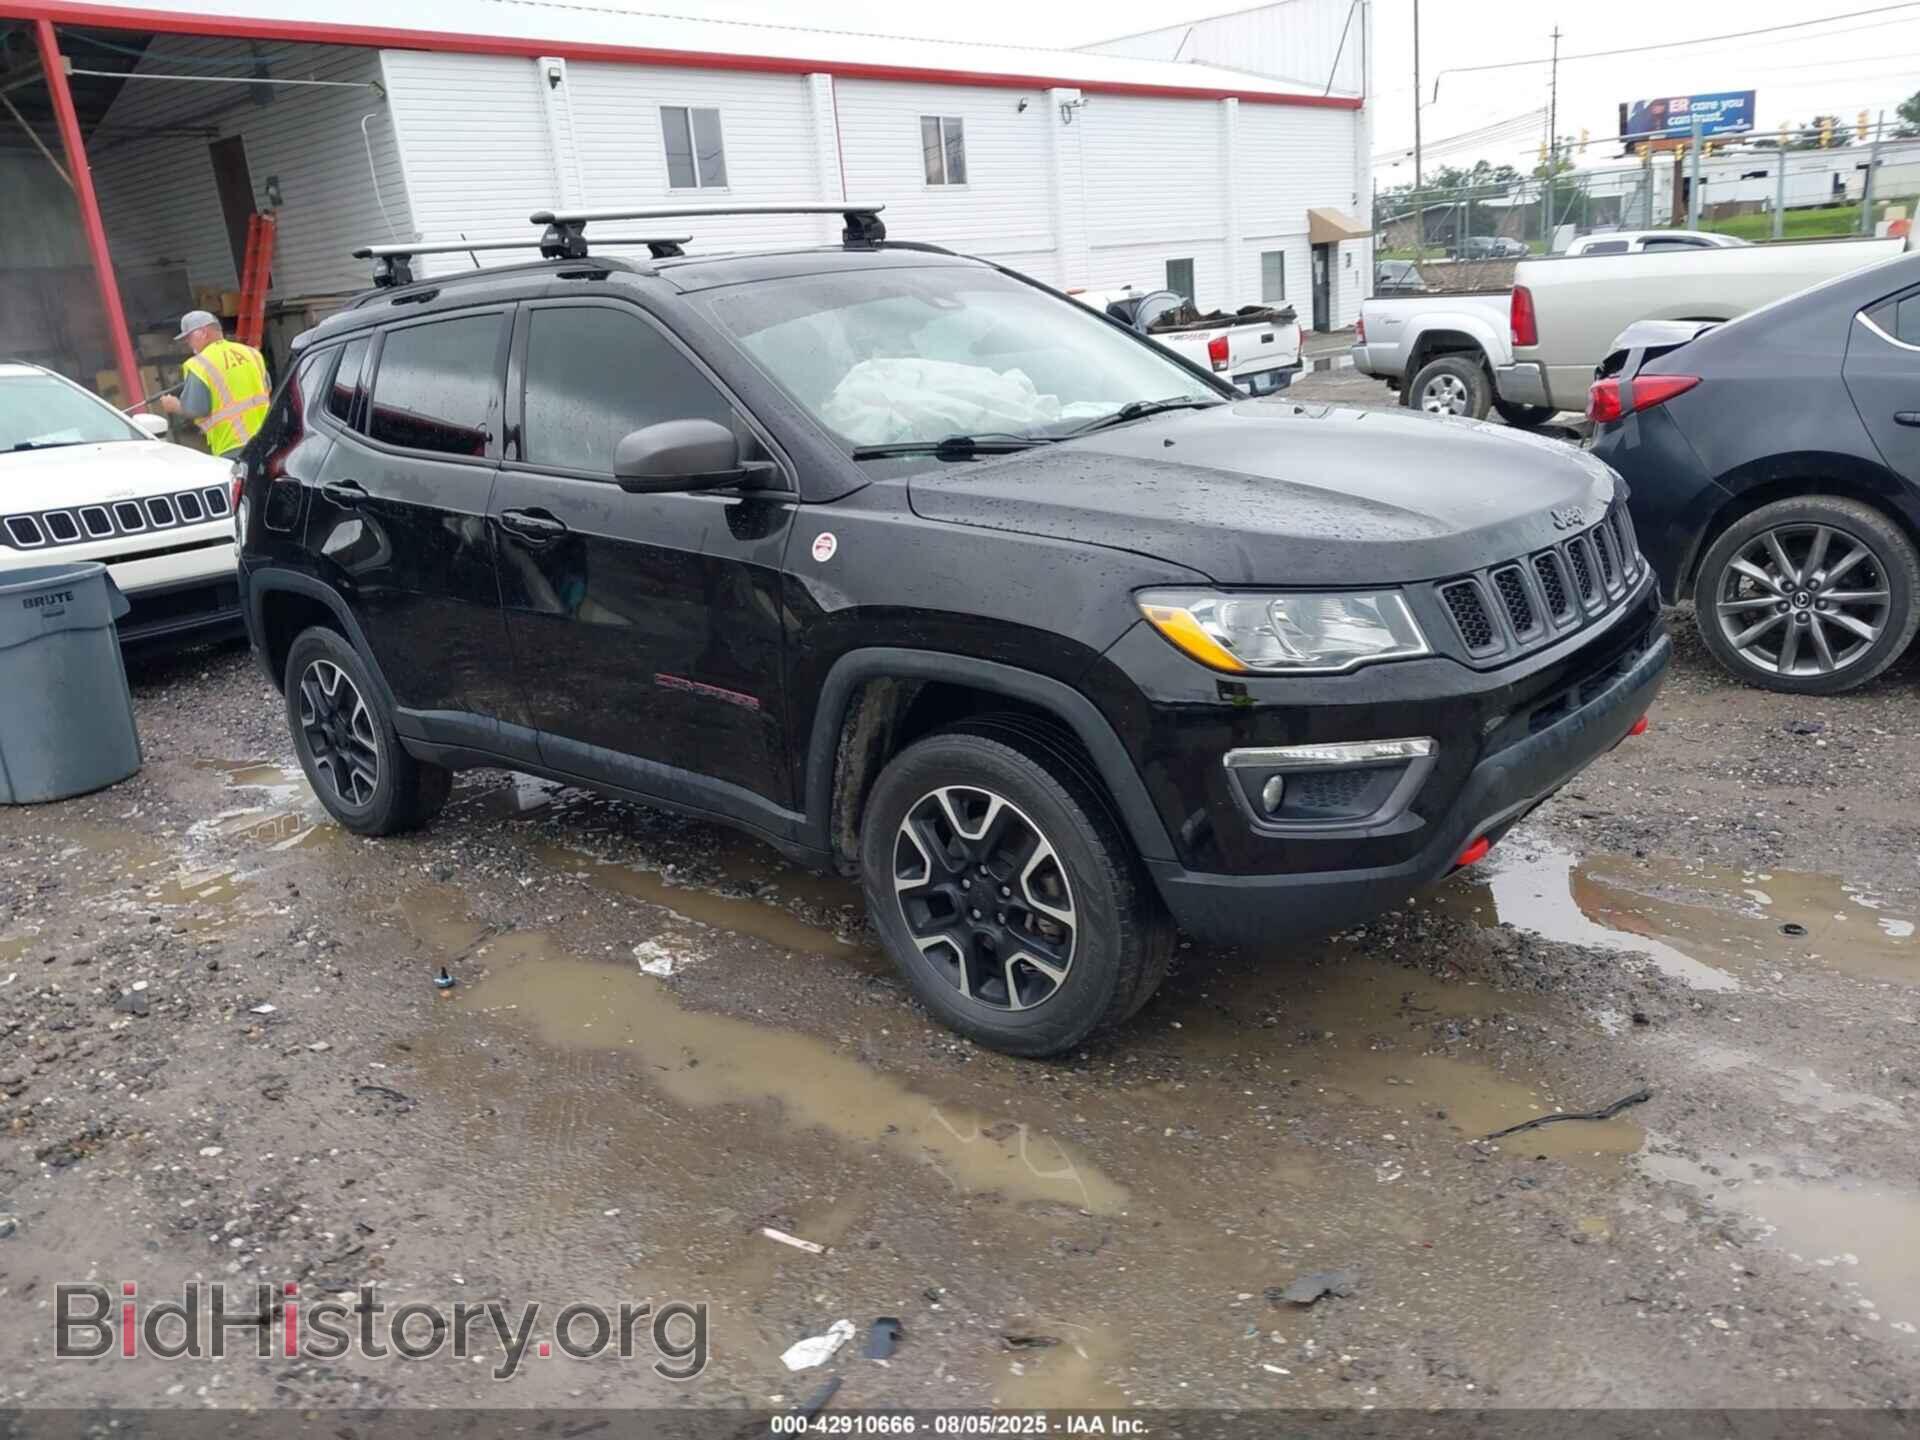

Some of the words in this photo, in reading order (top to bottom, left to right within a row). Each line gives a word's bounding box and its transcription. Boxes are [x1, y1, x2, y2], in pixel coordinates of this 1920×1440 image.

[1669, 98, 1689, 113] ER
[1691, 100, 1719, 111] care
[1721, 98, 1745, 113] you
[1667, 115, 1691, 126] can
[22, 591, 74, 608] BRUTE
